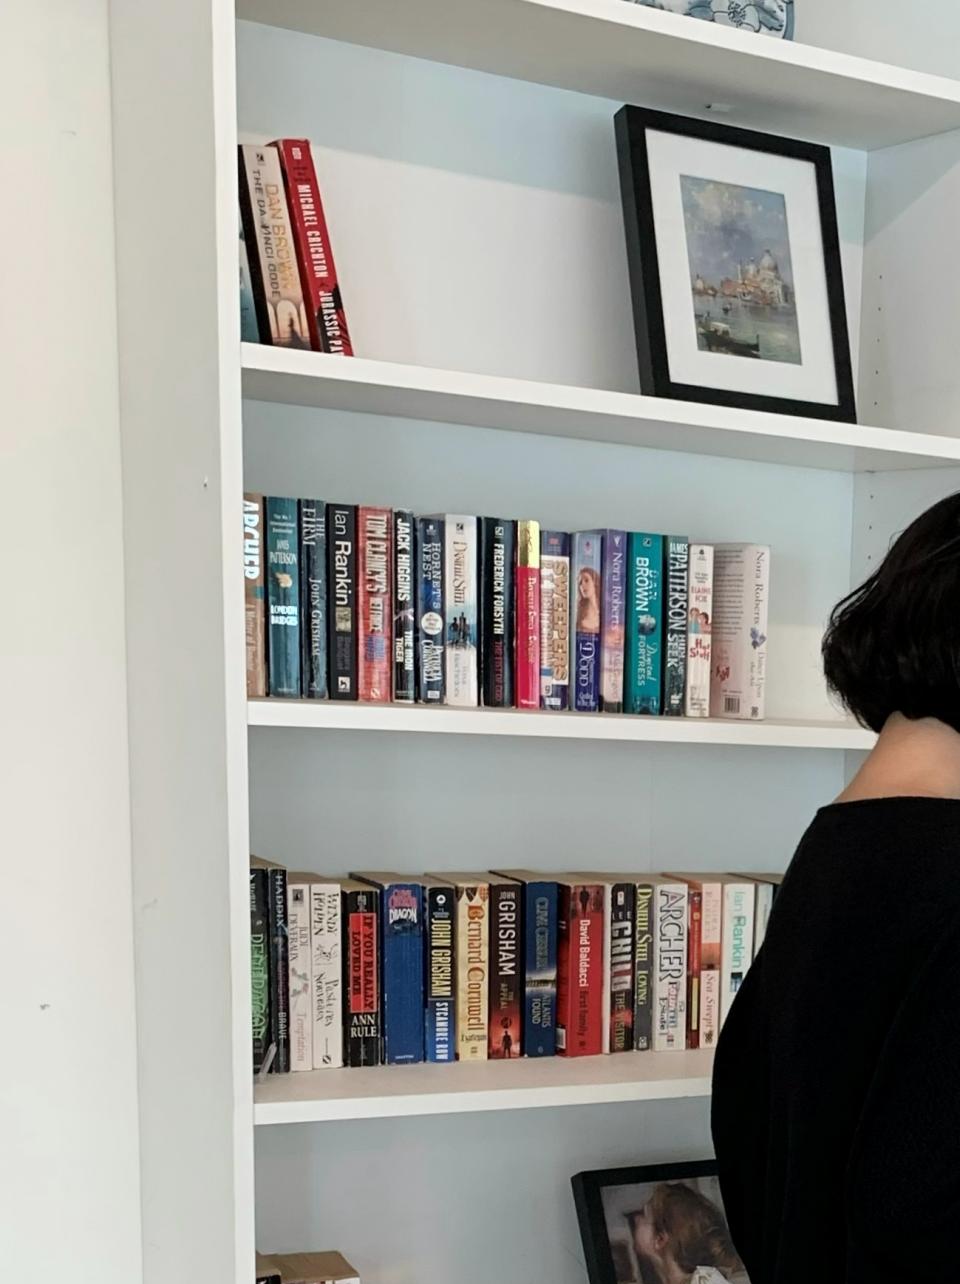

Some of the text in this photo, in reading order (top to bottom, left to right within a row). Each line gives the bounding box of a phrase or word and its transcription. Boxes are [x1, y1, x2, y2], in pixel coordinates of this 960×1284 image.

[252, 169, 264, 194] THE
[256, 199, 268, 218] DA
[265, 184, 293, 290] DAN BROWN
[297, 184, 329, 279] MICHAEL CRICHTON
[267, 263, 281, 297] CODE
[318, 290, 343, 336] JURASSIC
[303, 507, 315, 545] FIRM
[316, 517, 325, 539] THE
[366, 514, 387, 593] TOM CLANCY'S
[335, 510, 351, 605] Ian Rankin
[397, 519, 410, 601] JACK HIGGINS
[423, 542, 431, 581] NEST
[432, 542, 441, 609] HORNET'S
[636, 557, 648, 612] BROWN
[493, 543, 504, 635] FREDERICK FORSYTH
[611, 552, 623, 630] Nora Roberts
[668, 555, 687, 630] PATTERSON
[754, 551, 765, 624] Nora Roberts
[309, 578, 323, 657] JOHN GRISHAM
[553, 561, 568, 681] SWEEPERS
[396, 637, 404, 662] TIGER
[404, 630, 413, 670] THE IRON
[579, 642, 595, 687] DODD
[638, 635, 646, 686] FORTRESS
[667, 633, 677, 667] SEEK
[276, 875, 284, 928] HADDIX
[313, 892, 326, 936] HOLDEN
[326, 892, 339, 936] WENDY
[389, 908, 417, 923] DRAGON
[732, 891, 747, 968] Ian Rankin
[363, 916, 374, 1009] IF YOU REALLY
[431, 918, 451, 996] JOHN GRISHAM
[466, 905, 486, 963] Bernard
[498, 901, 515, 975] GRISHAM
[579, 919, 590, 987] David Baldacci
[611, 921, 631, 991] CHILD
[637, 888, 653, 1005] DANIELLE STEEL LOVING
[659, 890, 686, 982] ARCHER
[352, 931, 361, 995] LOVED ME
[278, 1012, 287, 1039] BRAVE
[351, 1014, 375, 1026] ANN
[466, 967, 485, 1031] Cornwell
[532, 998, 541, 1024] FOUND
[542, 994, 551, 1027] ATLANTIS
[615, 992, 626, 1049] THE VISITOR
[702, 973, 715, 1029] Sea Swept
[351, 1027, 377, 1038] RULE
[436, 1002, 448, 1060] SYCAMORE ROW
